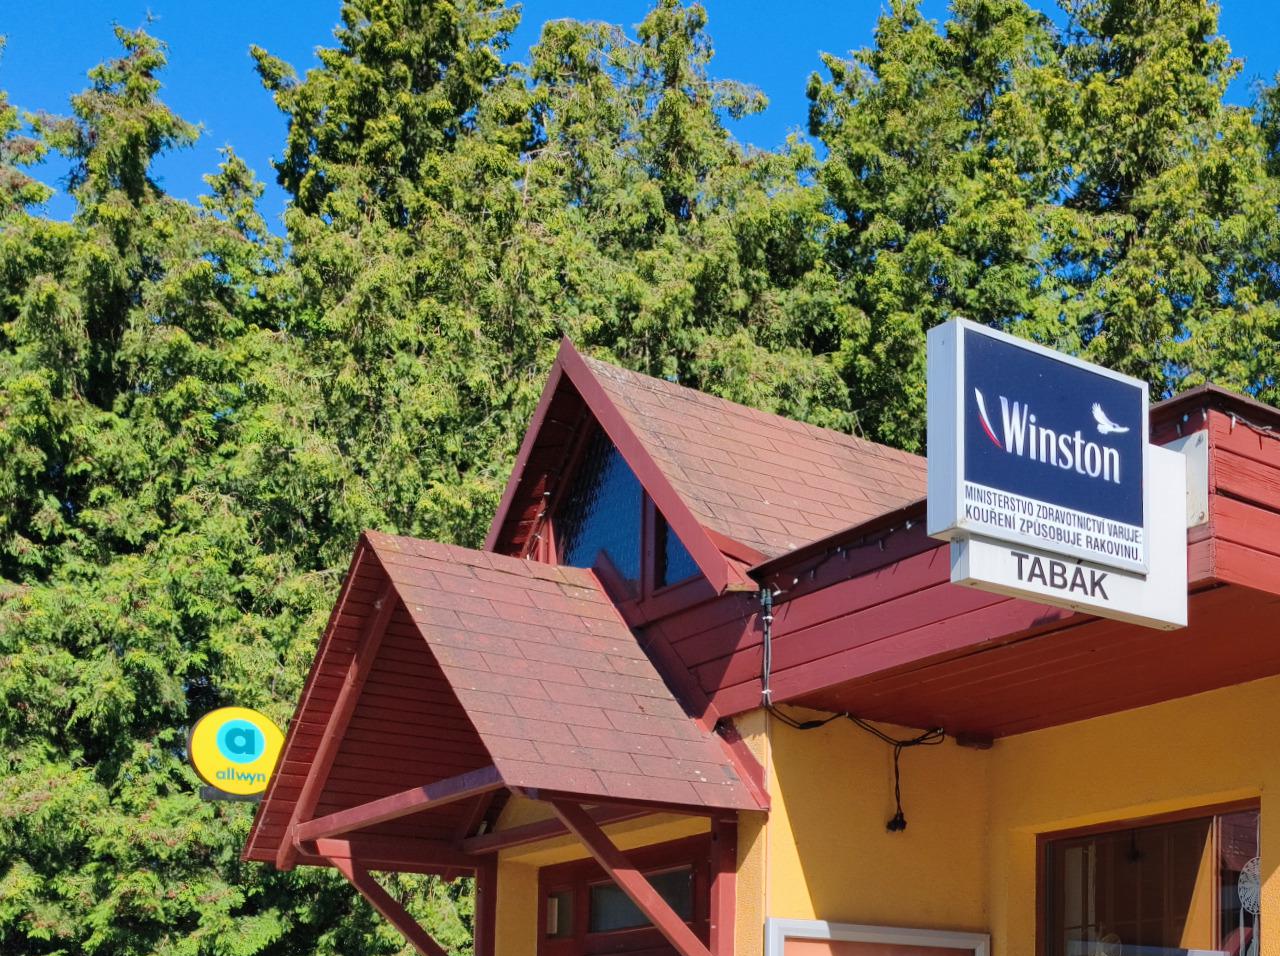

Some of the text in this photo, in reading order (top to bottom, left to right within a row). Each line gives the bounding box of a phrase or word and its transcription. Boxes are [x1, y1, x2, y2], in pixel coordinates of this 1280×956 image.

[999, 396, 1121, 485] Winston
[964, 484, 1142, 545] MINISTERSTVO ZDRAVOTNICTVÍ VARUJE:
[965, 503, 1142, 562] KOUŘENÍ ZPŮSOBUJE RAKOVINU.
[1011, 551, 1110, 601] TABÁK
[215, 767, 266, 785] allwyn
